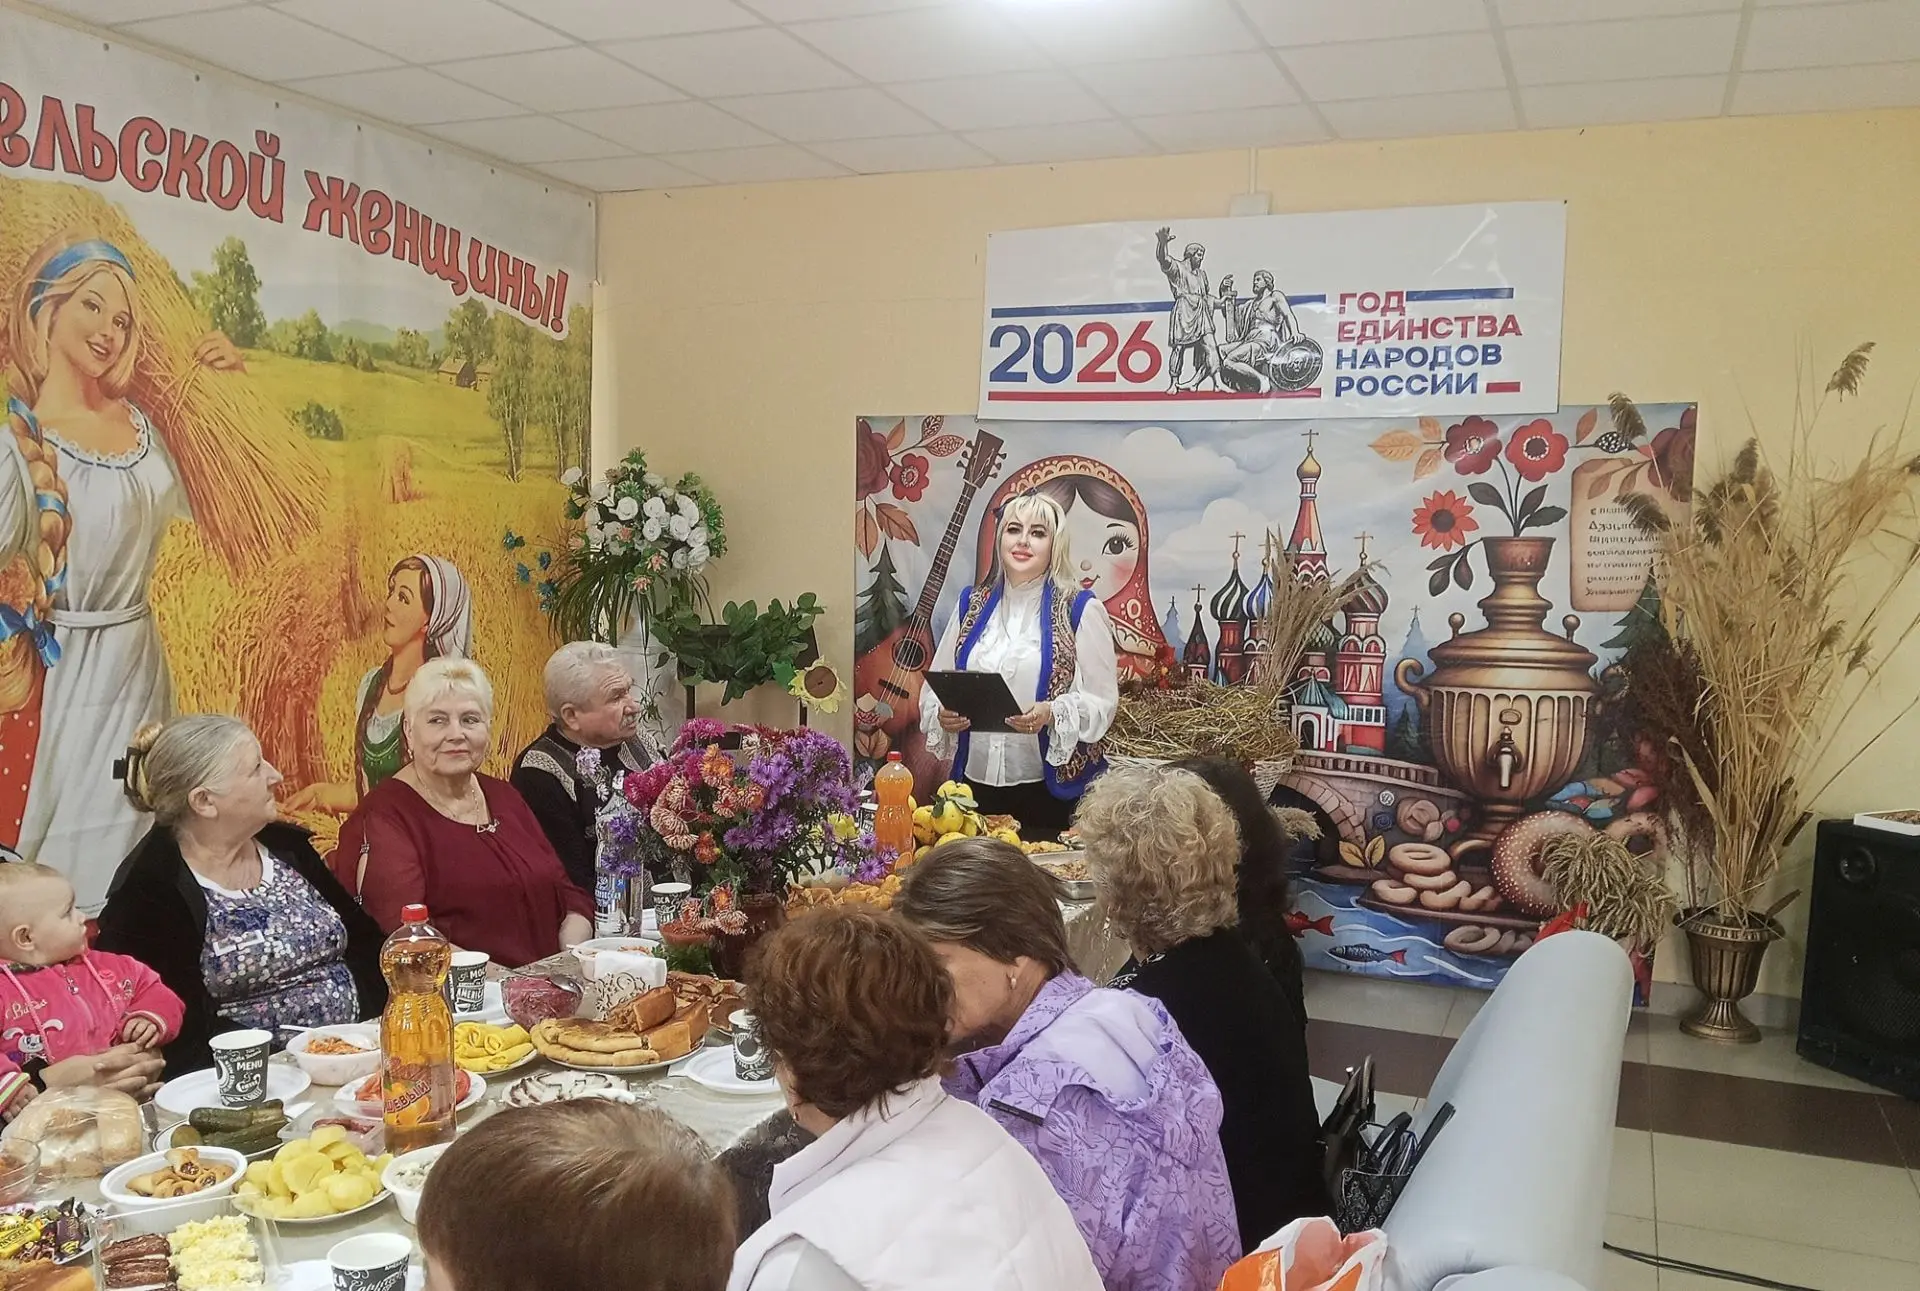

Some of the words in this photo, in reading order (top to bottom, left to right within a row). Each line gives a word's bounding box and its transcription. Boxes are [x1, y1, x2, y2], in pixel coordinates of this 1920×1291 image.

[1339, 290, 1406, 317] ГОД
[1337, 314, 1522, 345] ЕДИНСТВА
[989, 320, 1162, 384] 2026
[1336, 343, 1503, 371] НАРОДОВ
[1335, 372, 1478, 397] РОССИИ
[236, 1059, 263, 1072] MENU
